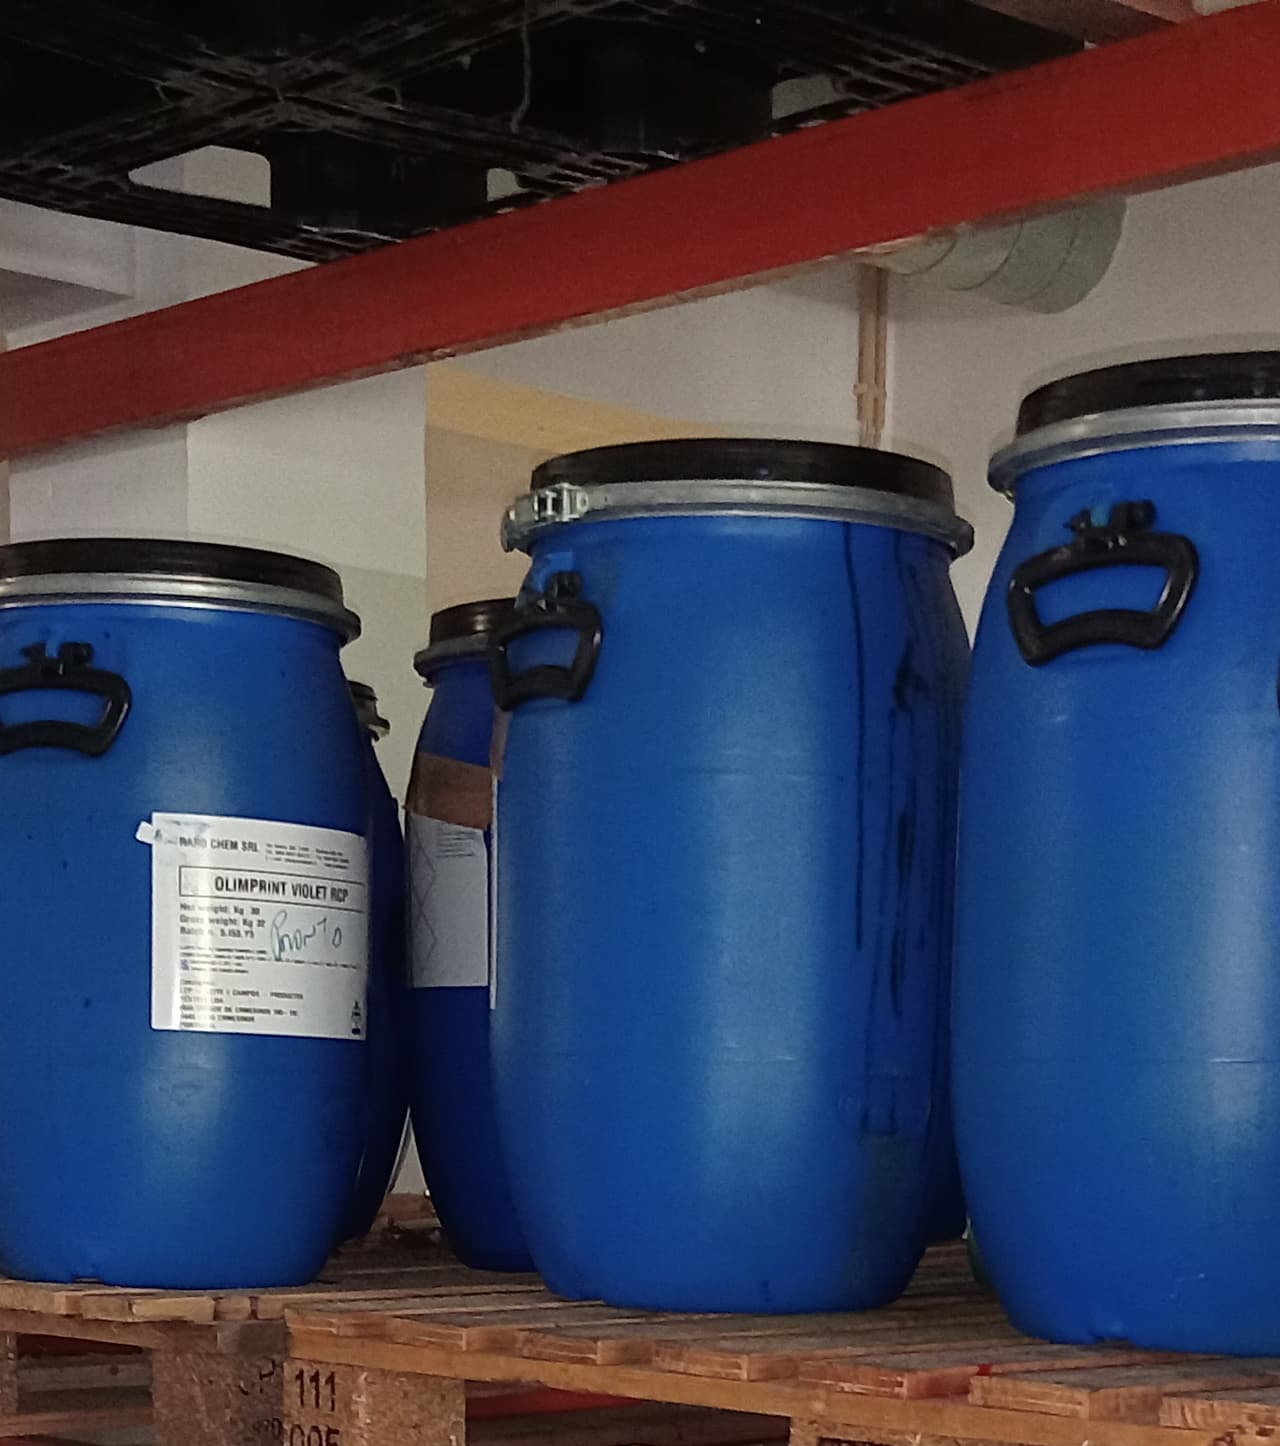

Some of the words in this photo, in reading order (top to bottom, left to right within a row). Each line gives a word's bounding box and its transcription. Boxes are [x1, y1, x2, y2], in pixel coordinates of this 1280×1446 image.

[211, 838, 238, 850] CHEM
[214, 875, 287, 896] OLIMPRINT
[291, 882, 328, 900] VIOLET
[295, 1369, 336, 1411] 111
